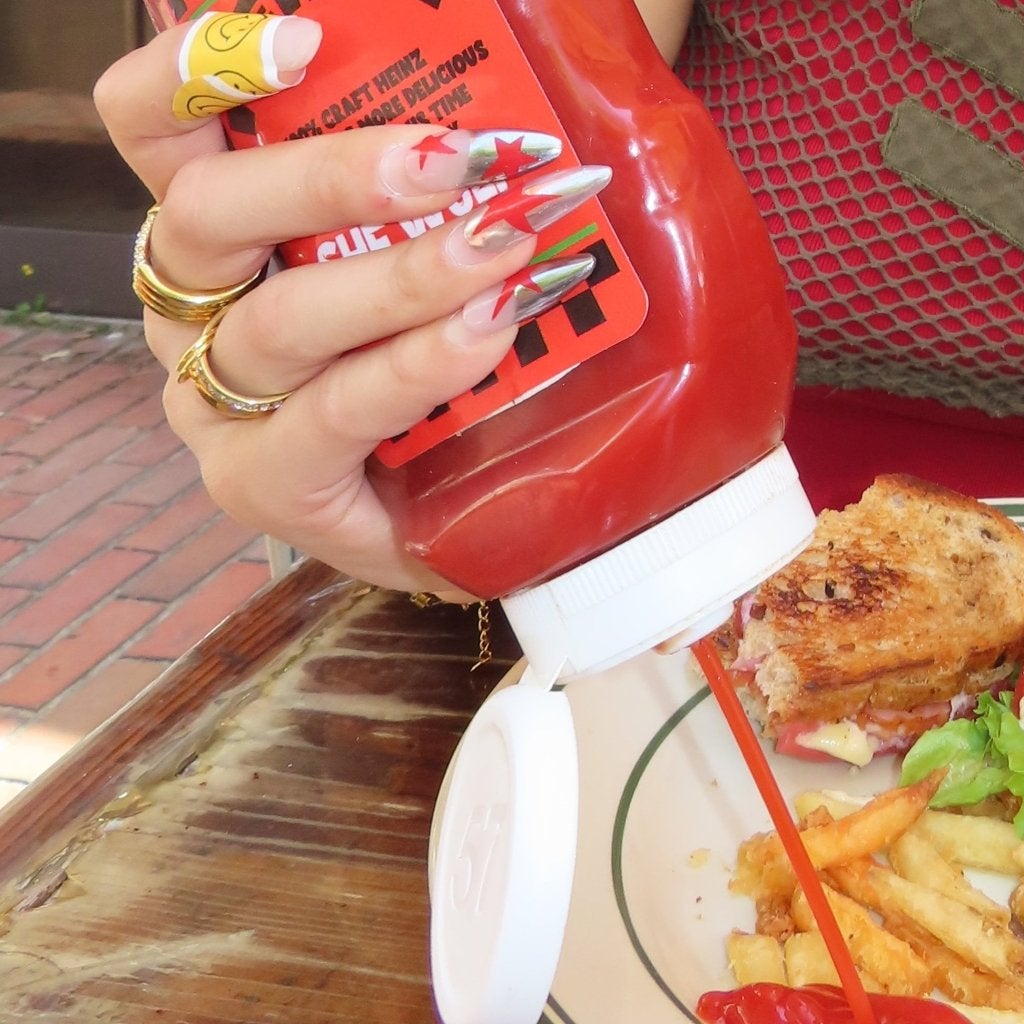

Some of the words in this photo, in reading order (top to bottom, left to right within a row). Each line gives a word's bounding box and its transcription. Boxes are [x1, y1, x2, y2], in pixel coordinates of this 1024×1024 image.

[371, 47, 428, 95] HEINZ
[402, 39, 490, 108] DELICIOUS
[428, 82, 473, 122] TIME
